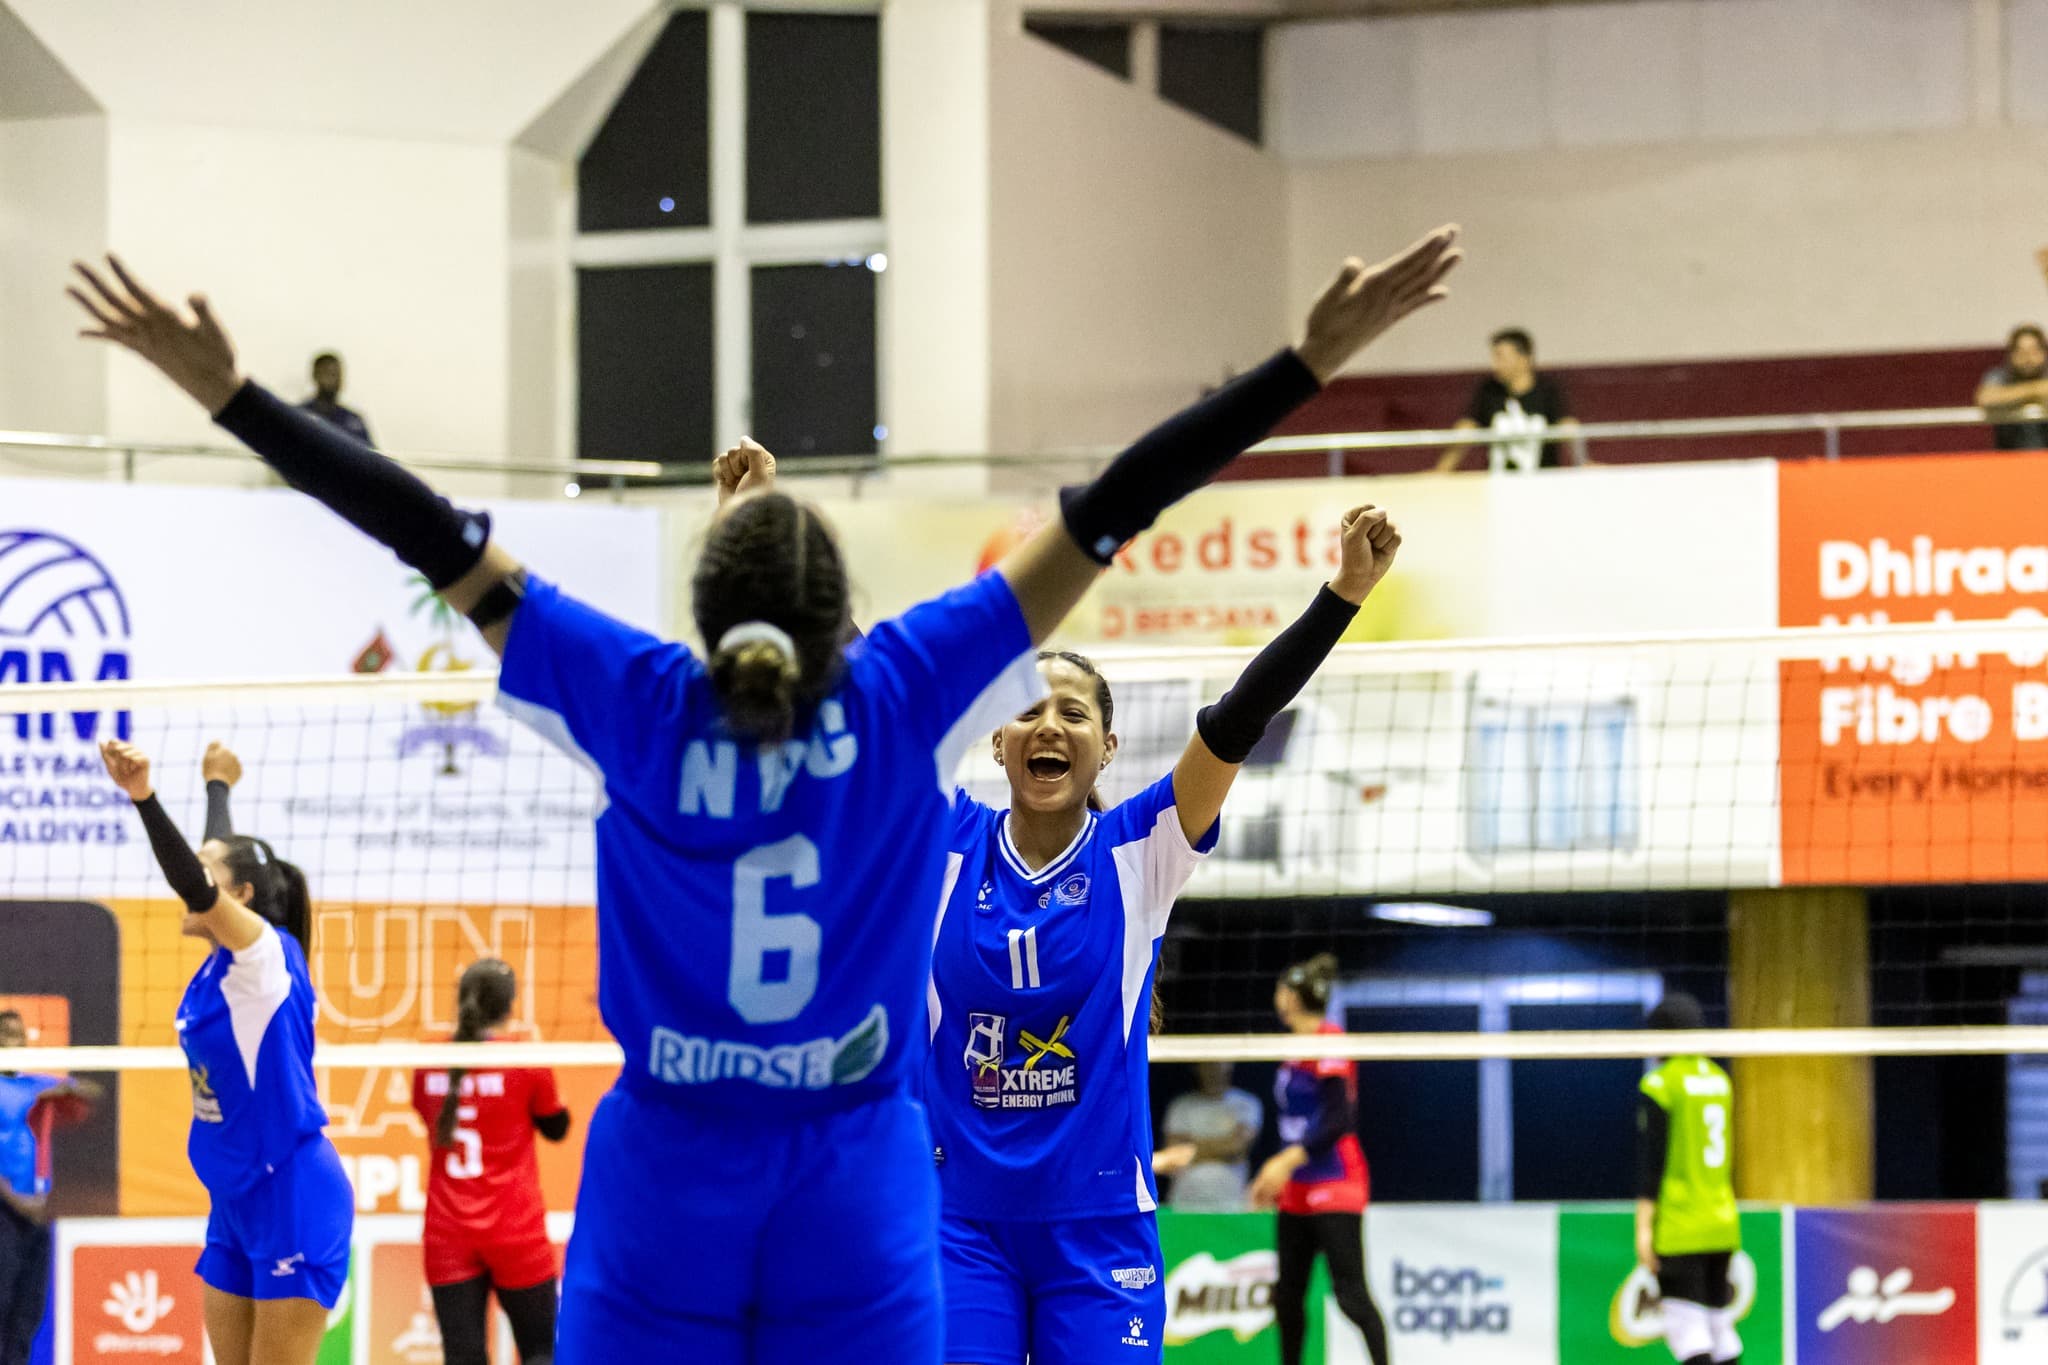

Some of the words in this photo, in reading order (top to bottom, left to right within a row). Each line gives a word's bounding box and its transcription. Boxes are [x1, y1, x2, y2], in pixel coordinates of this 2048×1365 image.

[1820, 535, 2048, 600] Dhiraa
[1821, 684, 1992, 746] Fibre
[728, 833, 821, 1024] 6
[1007, 926, 1040, 989] 11
[1001, 1065, 1075, 1091] XTREME
[1002, 1095, 1044, 1107] ENERGY
[1046, 1089, 1076, 1106] DRINK
[445, 1106, 484, 1179] 5
[1703, 1103, 1726, 1169] 3
[343, 1154, 426, 1212] PL
[1121, 1336, 1149, 1346] KELME
[1396, 1303, 1510, 1341] aqua
